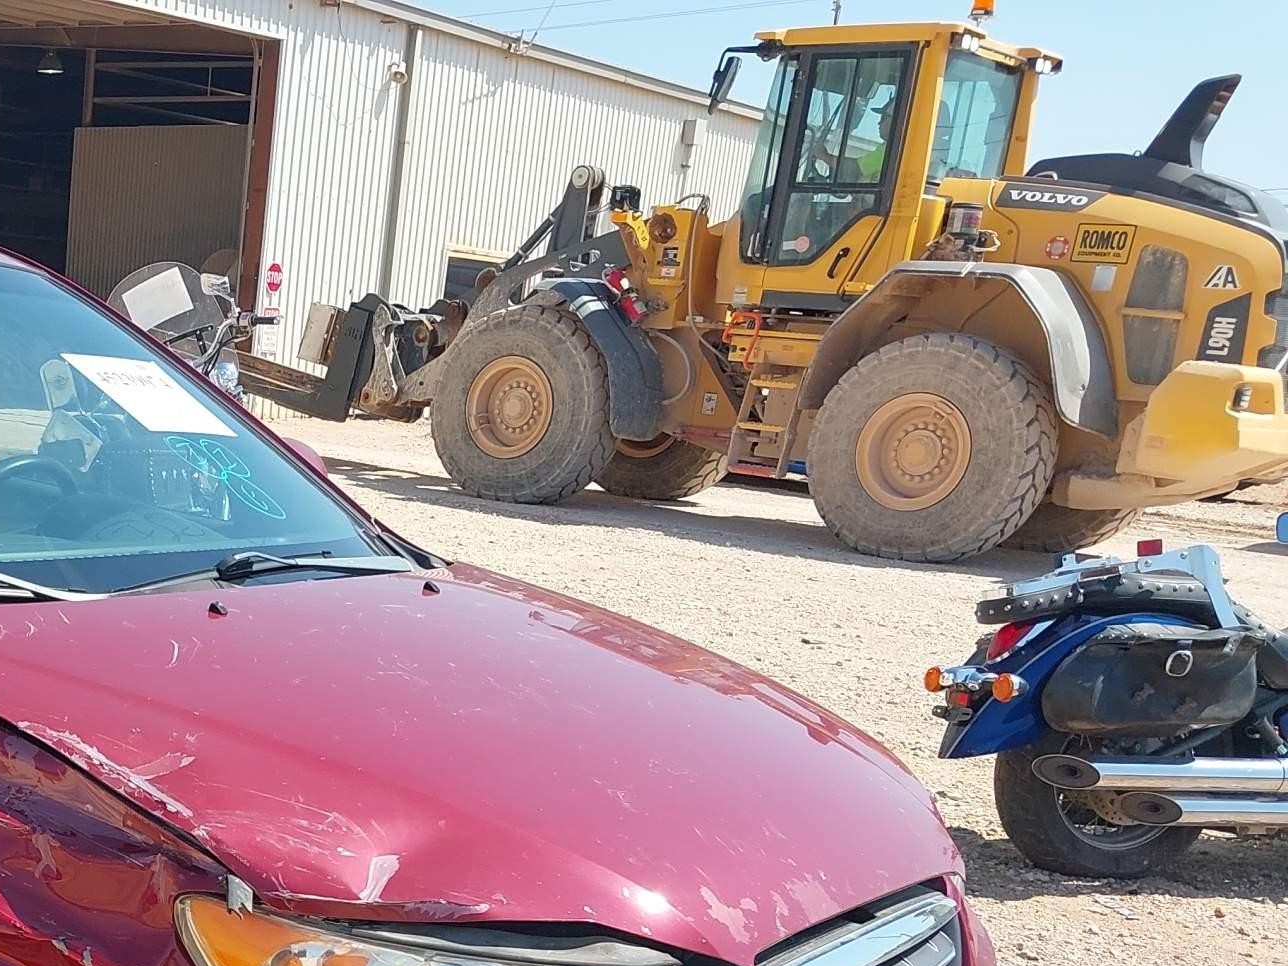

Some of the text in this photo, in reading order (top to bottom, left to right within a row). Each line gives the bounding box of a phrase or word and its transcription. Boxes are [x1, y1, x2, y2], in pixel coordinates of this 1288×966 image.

[1009, 189, 1088, 206] VOLVO
[1079, 229, 1128, 250] ROMCO
[267, 271, 283, 285] STOP
